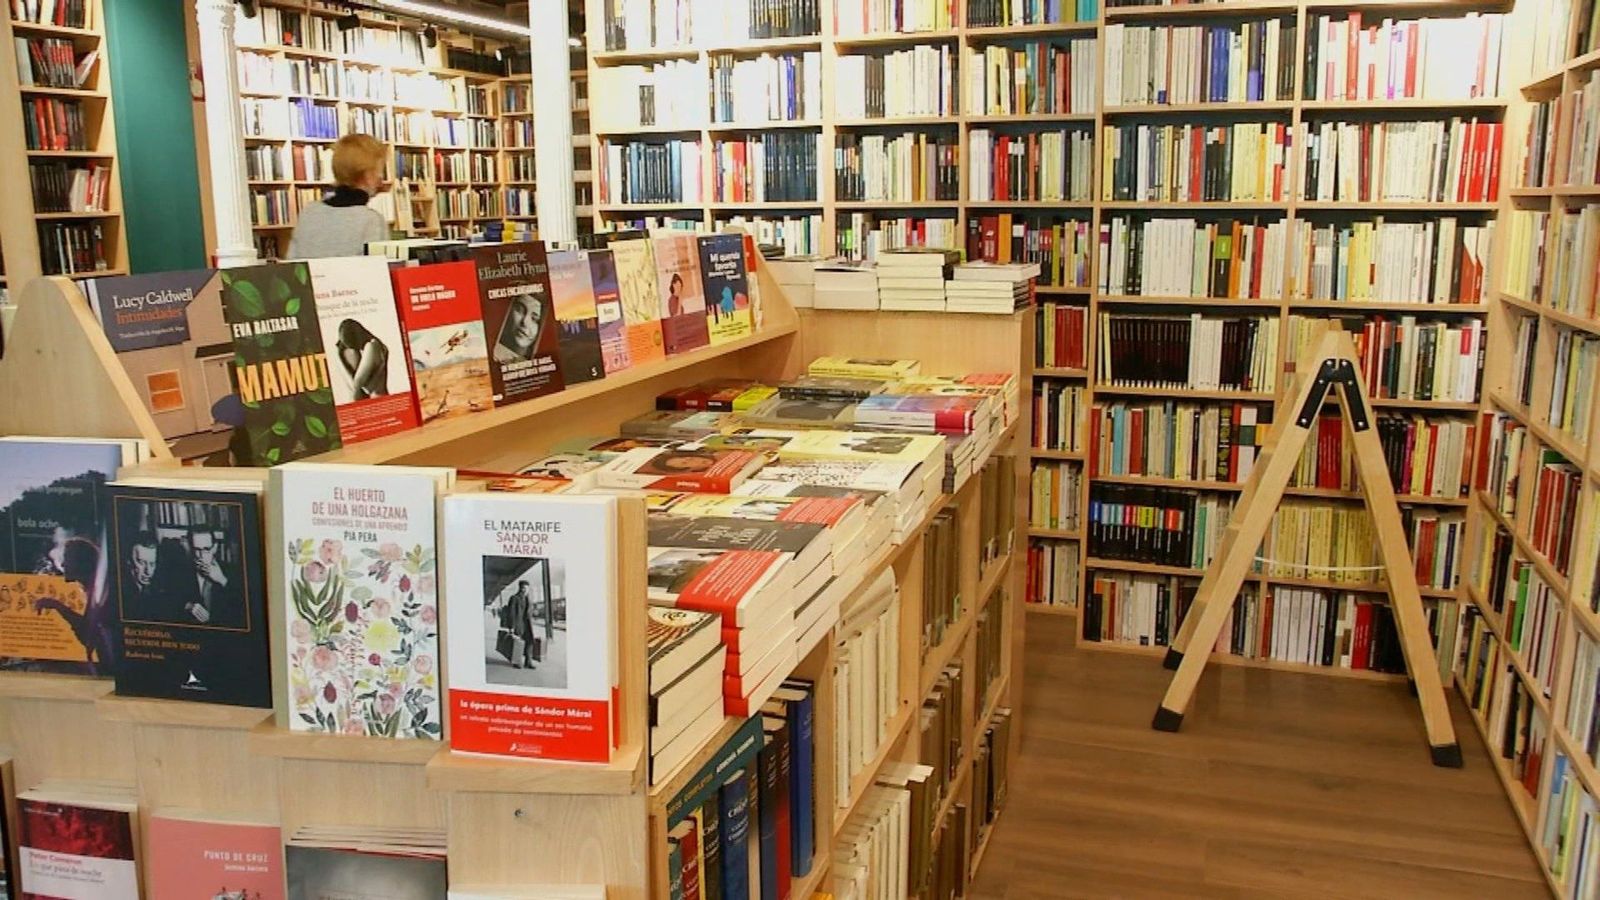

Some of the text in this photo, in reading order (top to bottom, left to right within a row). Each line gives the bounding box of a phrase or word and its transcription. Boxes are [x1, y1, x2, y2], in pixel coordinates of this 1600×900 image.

[497, 251, 527, 264] Laurie
[479, 264, 521, 280] Elizabeth
[523, 262, 547, 275] Flynn
[112, 288, 193, 310] Lucy Caldwell
[331, 289, 359, 298] Barnes
[116, 306, 183, 325] Intimidades
[233, 316, 299, 338] EVA BALTASAR
[237, 353, 329, 403] MAMUT
[333, 487, 385, 503] EL HUERTO
[312, 502, 408, 521] DE UNA HOLGAZANA
[17, 517, 37, 528] bola
[484, 520, 561, 533] EL MATARIFE
[358, 531, 377, 543] PERA
[460, 700, 592, 718] la ópera prima de Sándor Márai
[488, 726, 512, 734] privado
[49, 855, 82, 864] Cameron
[204, 850, 269, 863] PUNTO DE CRUZ
[70, 866, 80, 874] de
